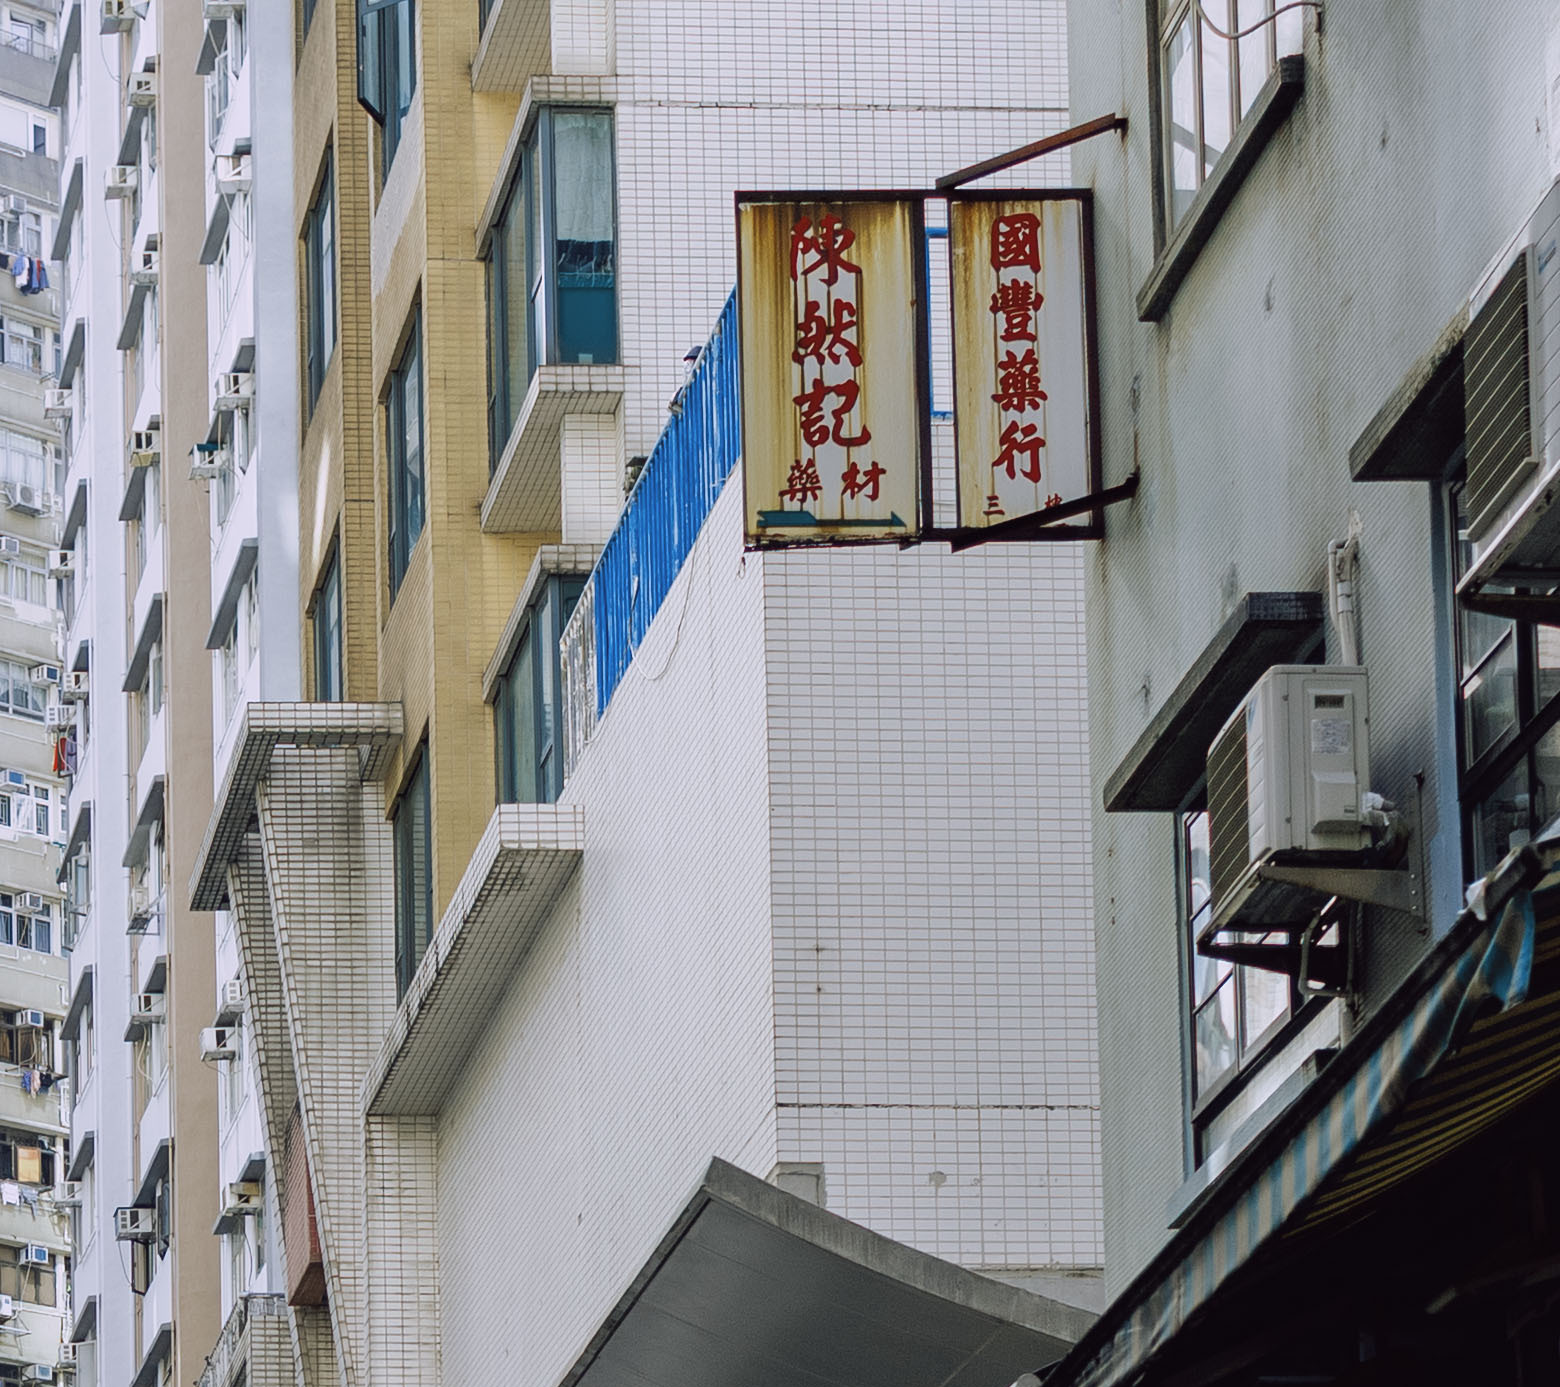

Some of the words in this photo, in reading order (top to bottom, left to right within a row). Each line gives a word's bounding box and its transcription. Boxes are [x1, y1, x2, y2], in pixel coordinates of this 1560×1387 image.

[790, 214, 871, 448] 陳然記
[779, 458, 886, 503] 藥材
